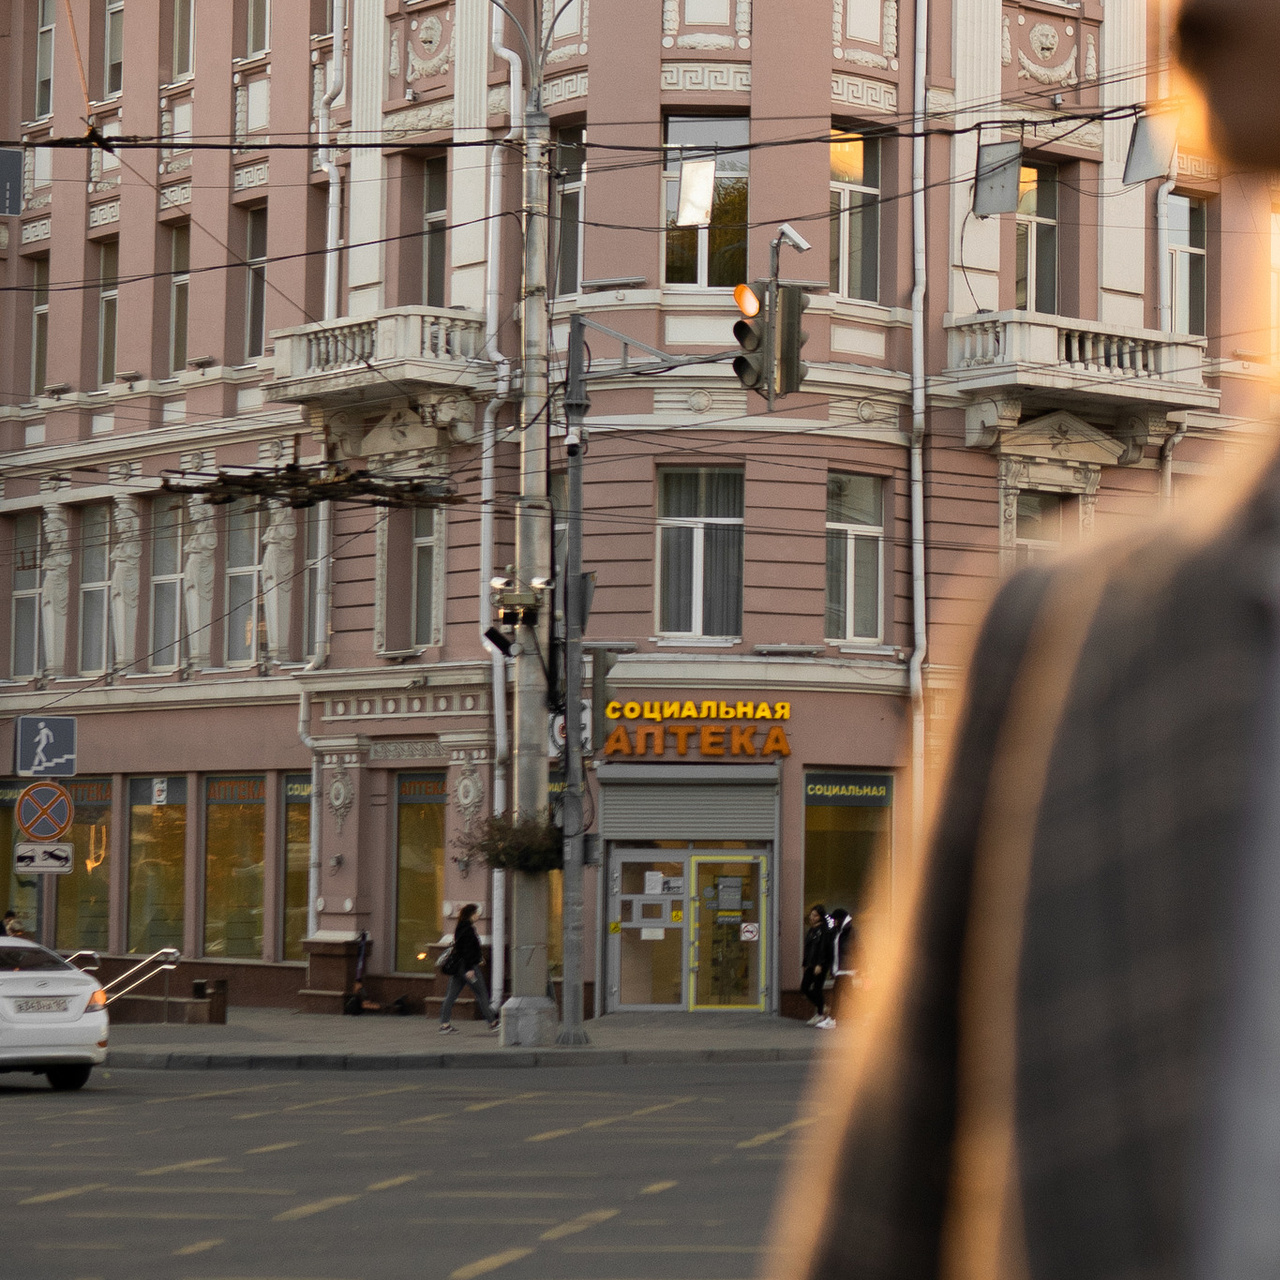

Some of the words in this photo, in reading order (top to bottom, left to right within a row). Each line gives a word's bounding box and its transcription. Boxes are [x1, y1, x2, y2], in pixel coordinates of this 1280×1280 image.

[605, 700, 791, 722] СОЦИАЛЬНАЯ
[603, 724, 792, 757] АПТЕКА
[807, 784, 887, 797] СОЦИАЛЬНАЯ
